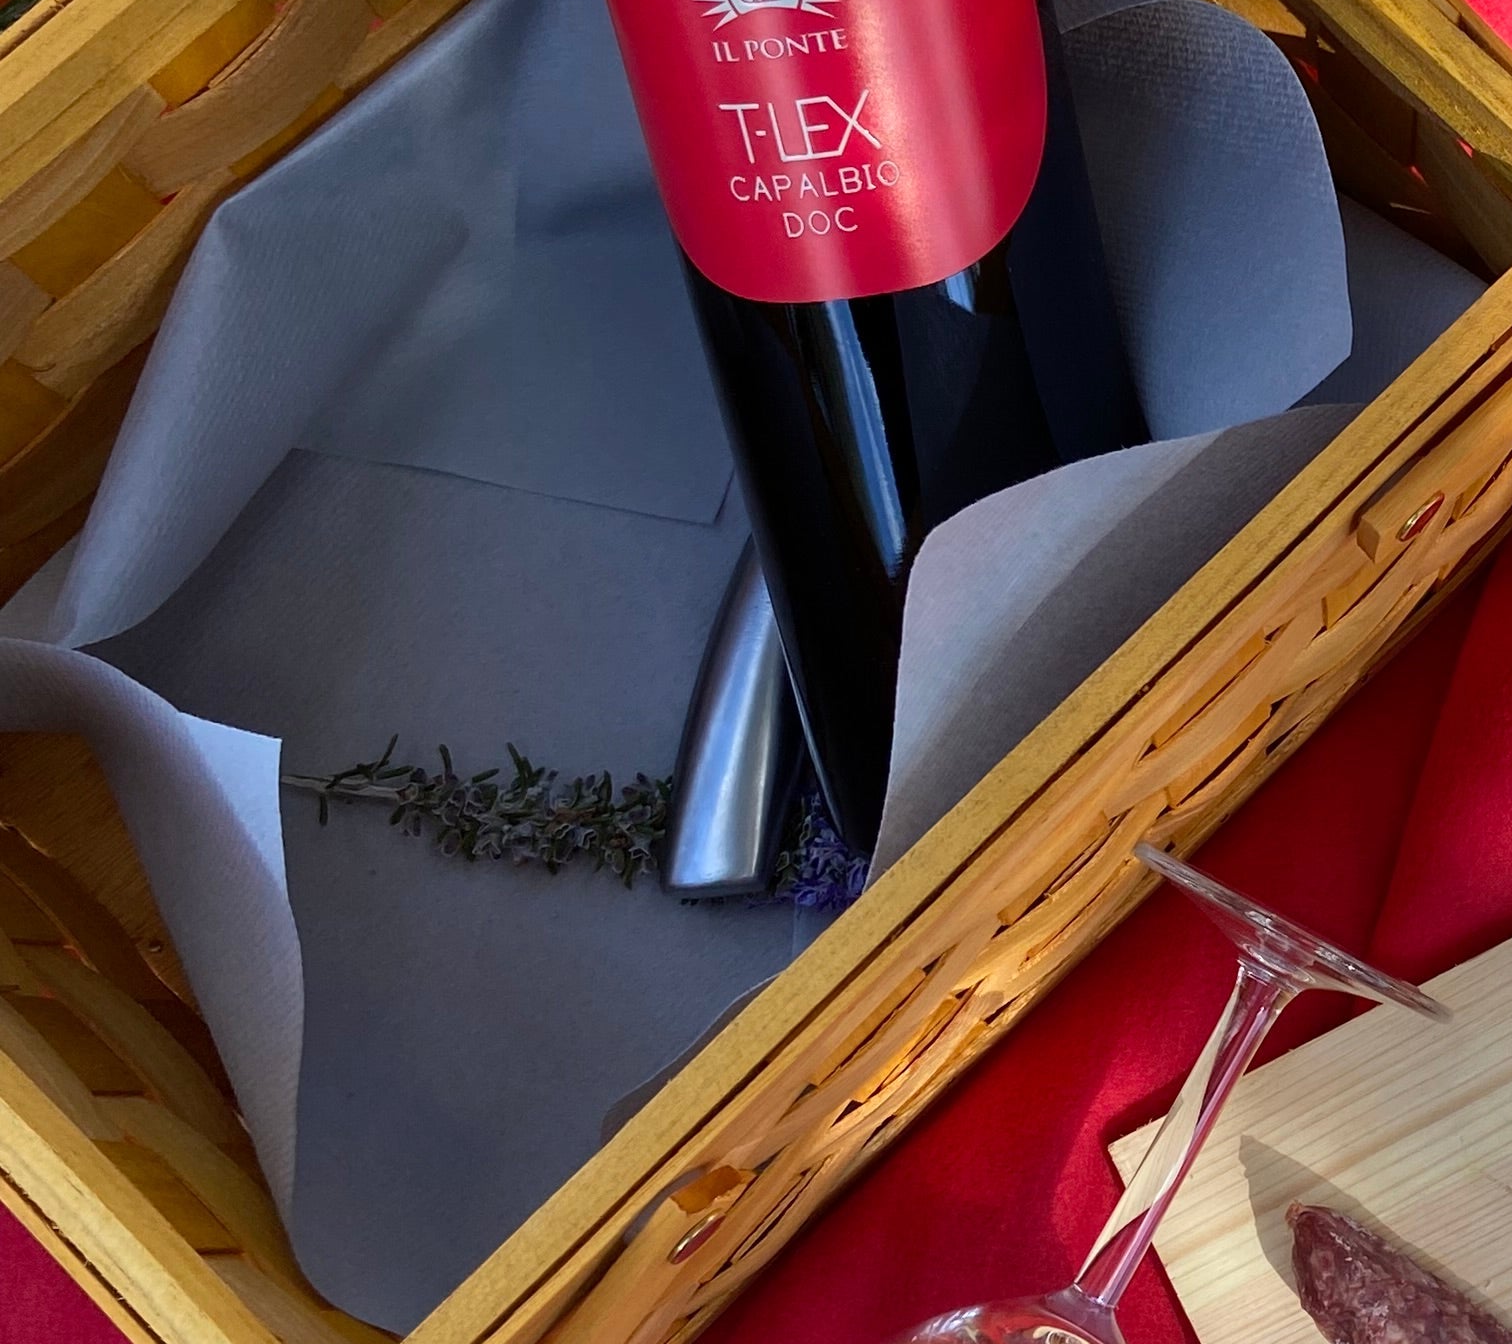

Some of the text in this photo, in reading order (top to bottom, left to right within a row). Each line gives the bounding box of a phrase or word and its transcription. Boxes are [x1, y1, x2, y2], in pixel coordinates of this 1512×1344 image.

[711, 28, 849, 63] IL PONTE
[717, 88, 883, 164] T-LEX
[729, 159, 901, 203] CAPALBIO
[782, 206, 859, 239] DOC
